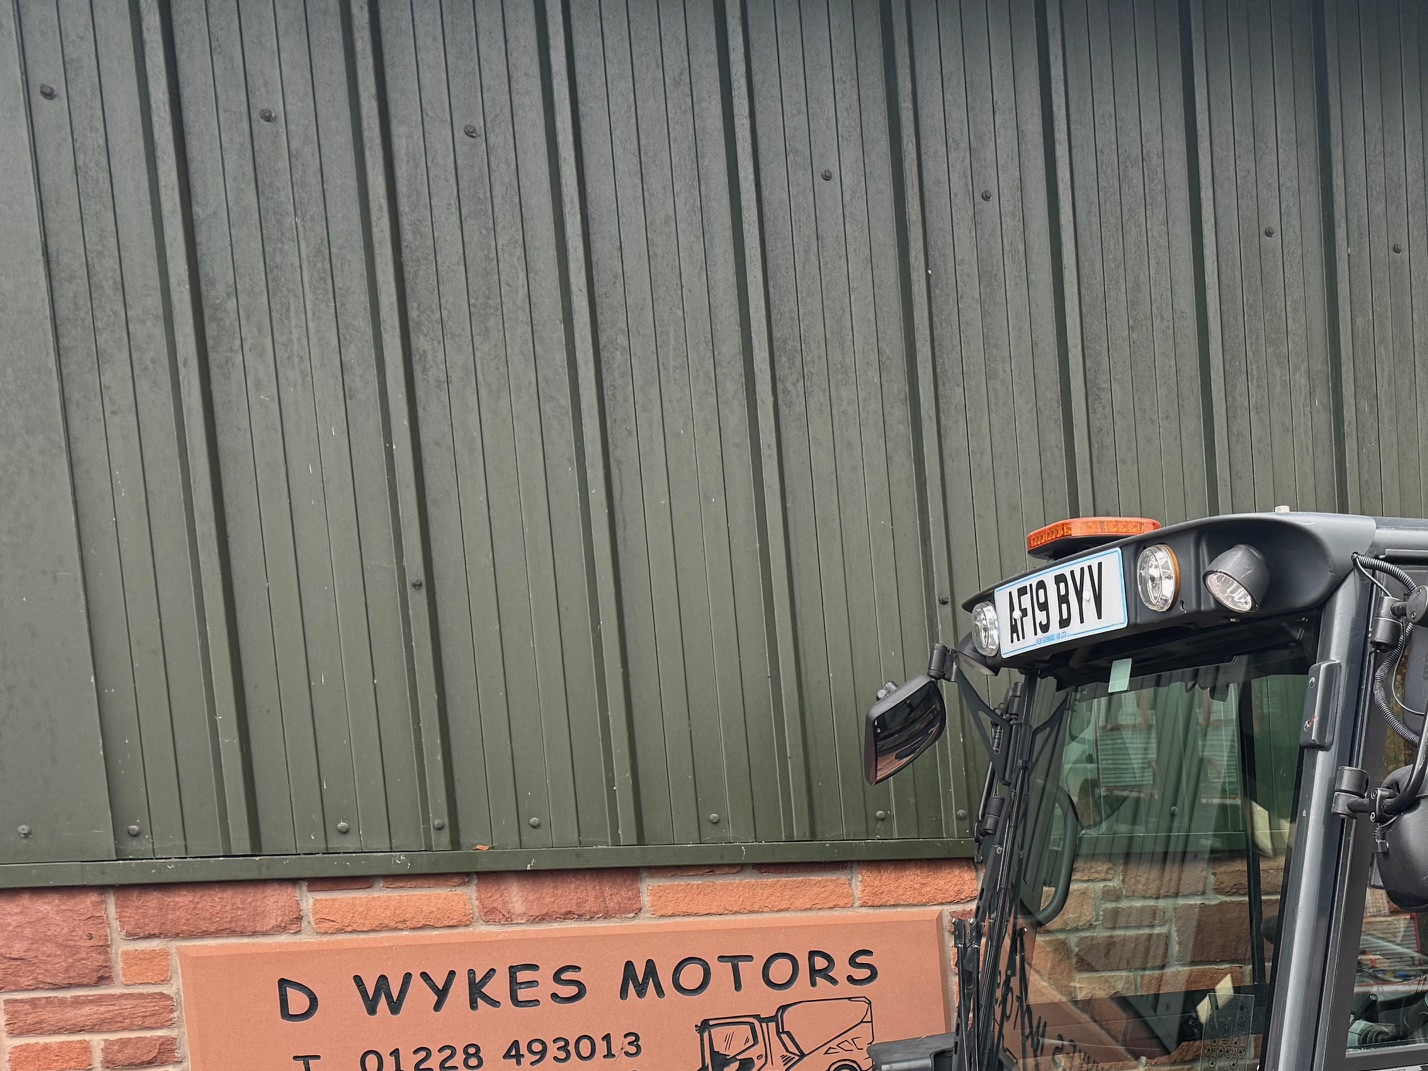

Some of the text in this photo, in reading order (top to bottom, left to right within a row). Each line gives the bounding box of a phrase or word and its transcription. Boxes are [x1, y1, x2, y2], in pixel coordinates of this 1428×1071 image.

[1009, 561, 1103, 643] AF19 BYV
[277, 948, 879, 1023] D WYKES MOTORS
[502, 1031, 642, 1067] 493013
